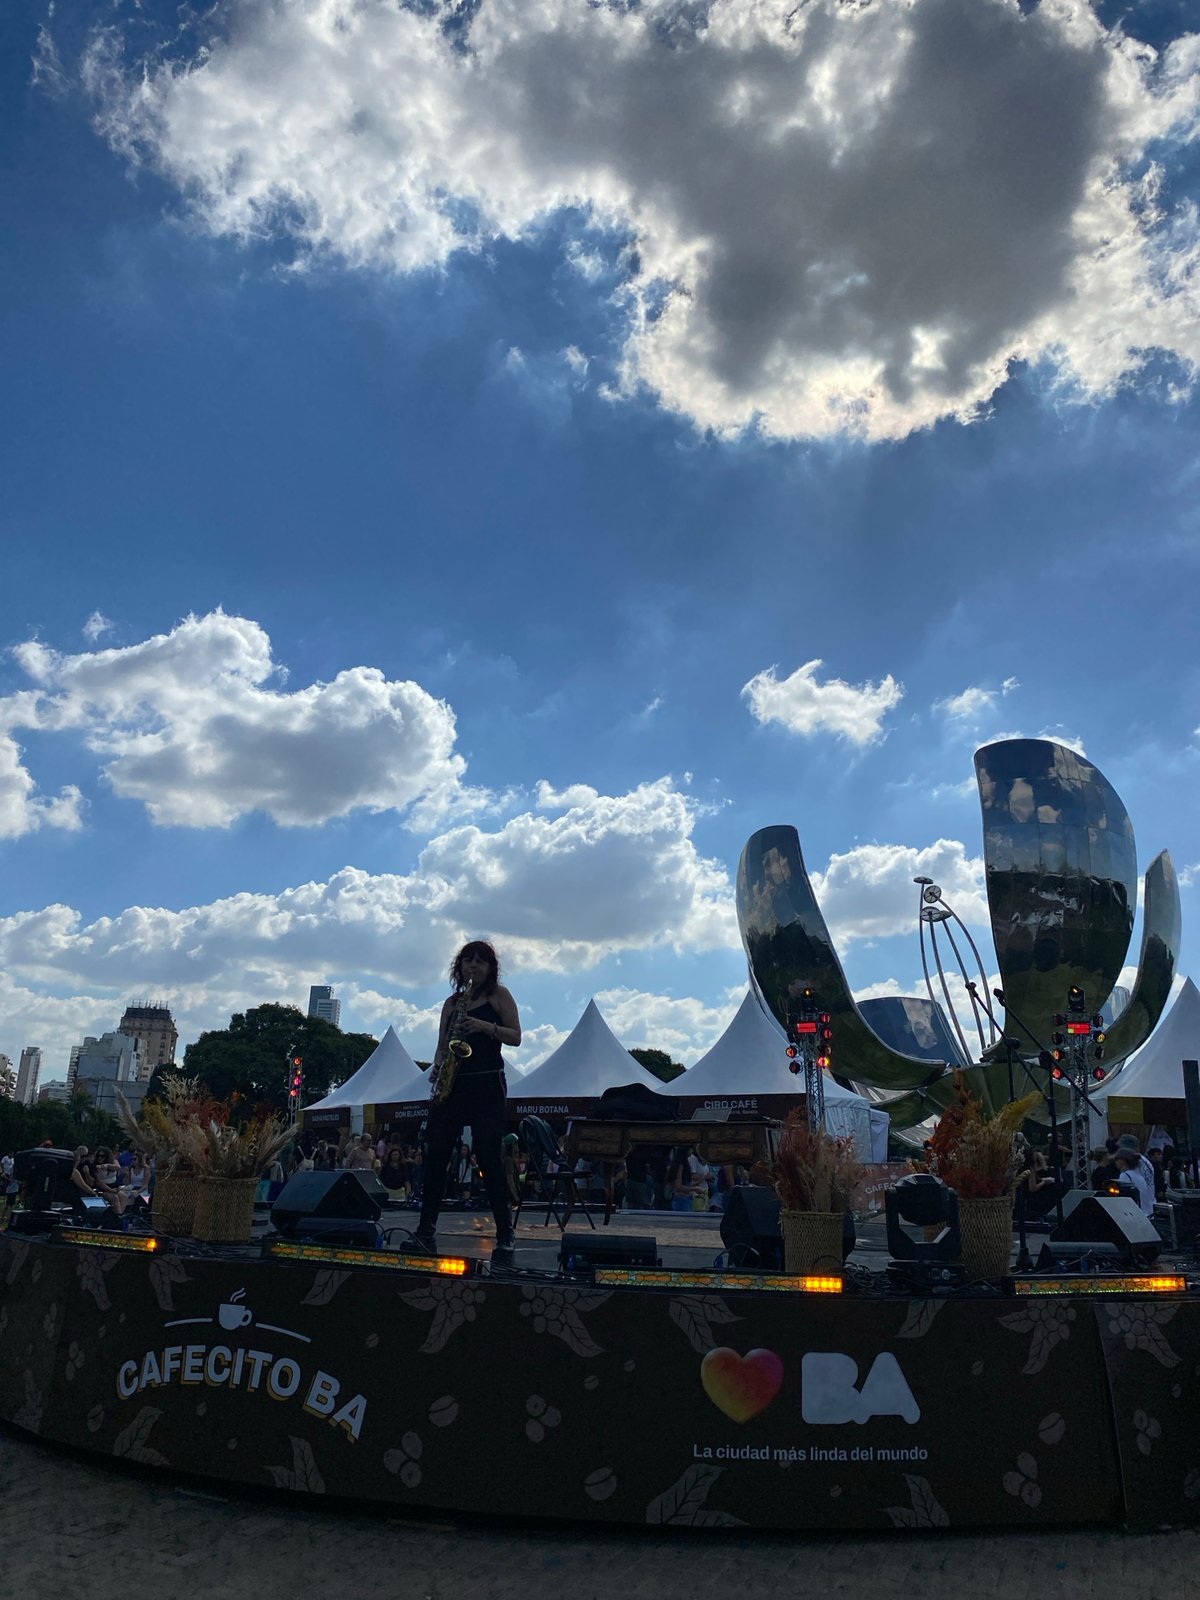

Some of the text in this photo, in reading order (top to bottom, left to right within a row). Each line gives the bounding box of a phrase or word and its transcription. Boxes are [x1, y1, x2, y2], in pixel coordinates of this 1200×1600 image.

[516, 1105, 569, 1114] MARU BOTANA
[704, 1098, 758, 1109] CIRO CAFÉ
[865, 1182, 897, 1194] CAFEC
[116, 1344, 369, 1445] CAFECITO BA
[801, 1351, 922, 1425] BA
[693, 1444, 929, 1462] La ciudad más linda del mundo
